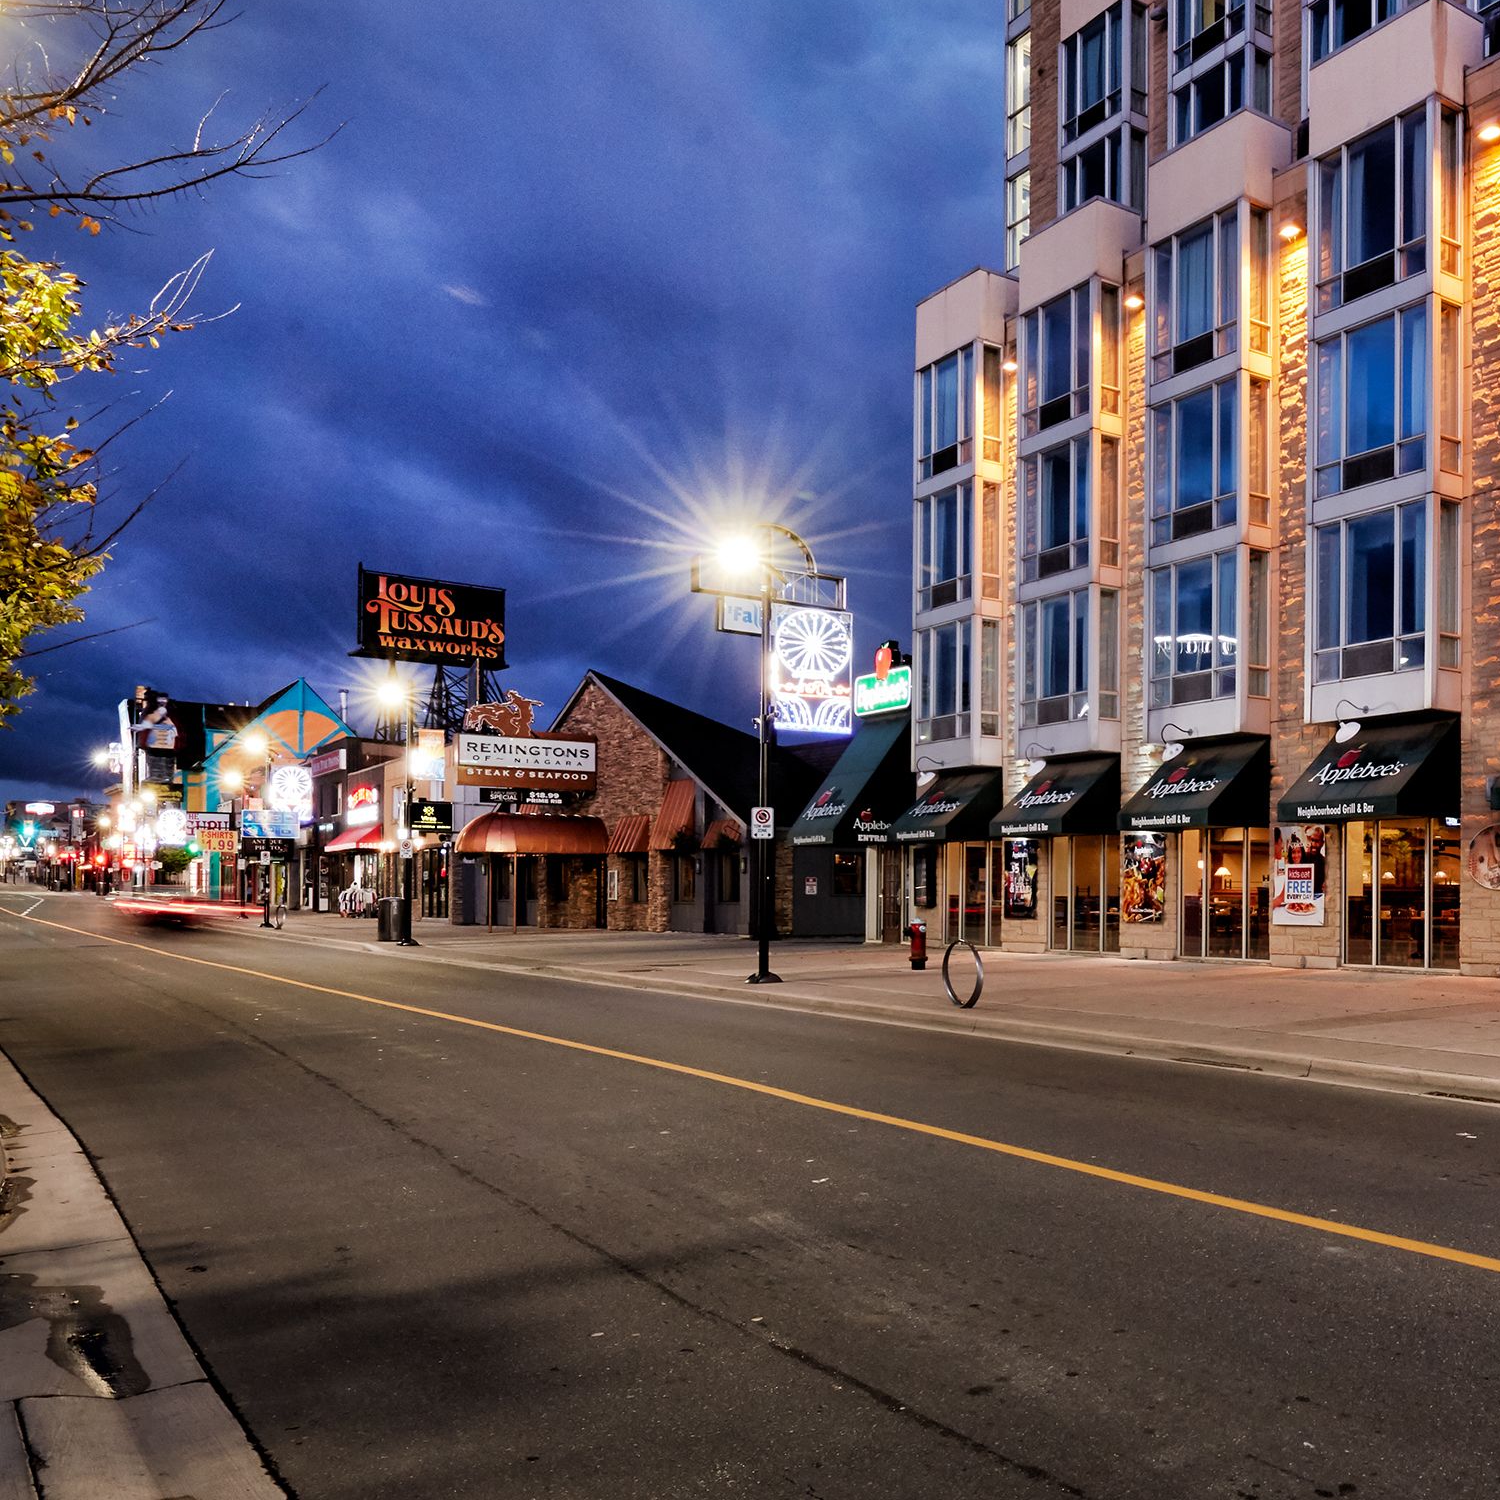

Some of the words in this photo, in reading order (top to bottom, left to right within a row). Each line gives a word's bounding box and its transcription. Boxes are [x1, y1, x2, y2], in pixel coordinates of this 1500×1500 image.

[377, 576, 456, 616] LOUIS
[366, 599, 505, 644] TUSSAUD'S
[378, 634, 498, 659] waxworks
[467, 742, 590, 759] REMINGTONS
[514, 757, 583, 766] NIAGARA
[466, 768, 510, 777] STEAK
[515, 770, 525, 778] &
[529, 771, 588, 781] SEAFOOD
[1308, 761, 1403, 786] Applebee's
[1143, 777, 1219, 799] Applebee's
[1297, 804, 1341, 819] Neighbourhood
[1342, 803, 1356, 814] Grill
[1357, 803, 1362, 813] &
[1363, 802, 1374, 813] Bar
[1289, 869, 1300, 878] kids
[1301, 870, 1310, 878] eat
[1287, 881, 1312, 893] FREE
